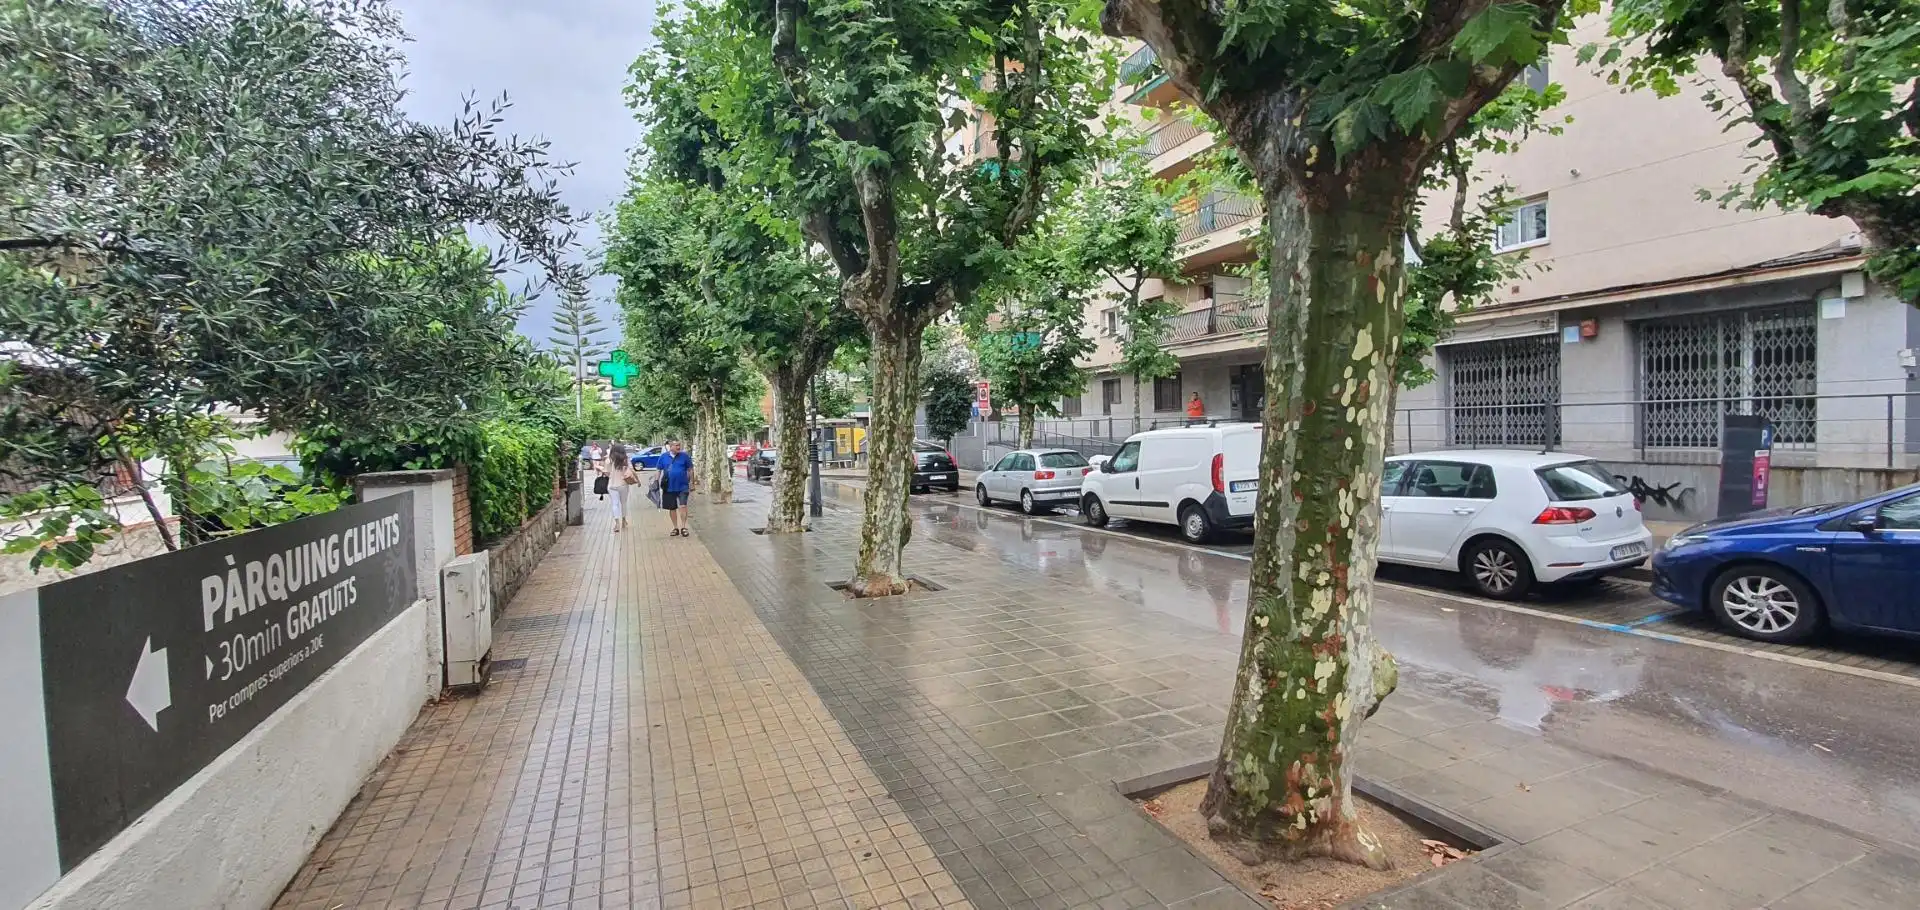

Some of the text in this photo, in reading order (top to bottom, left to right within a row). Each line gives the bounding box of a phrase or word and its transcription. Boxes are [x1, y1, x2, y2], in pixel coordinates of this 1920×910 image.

[202, 513, 400, 632] PÀRQUING CLIENTS
[209, 633, 324, 723] Per compres superiors a 20€
[219, 619, 282, 680] 30min
